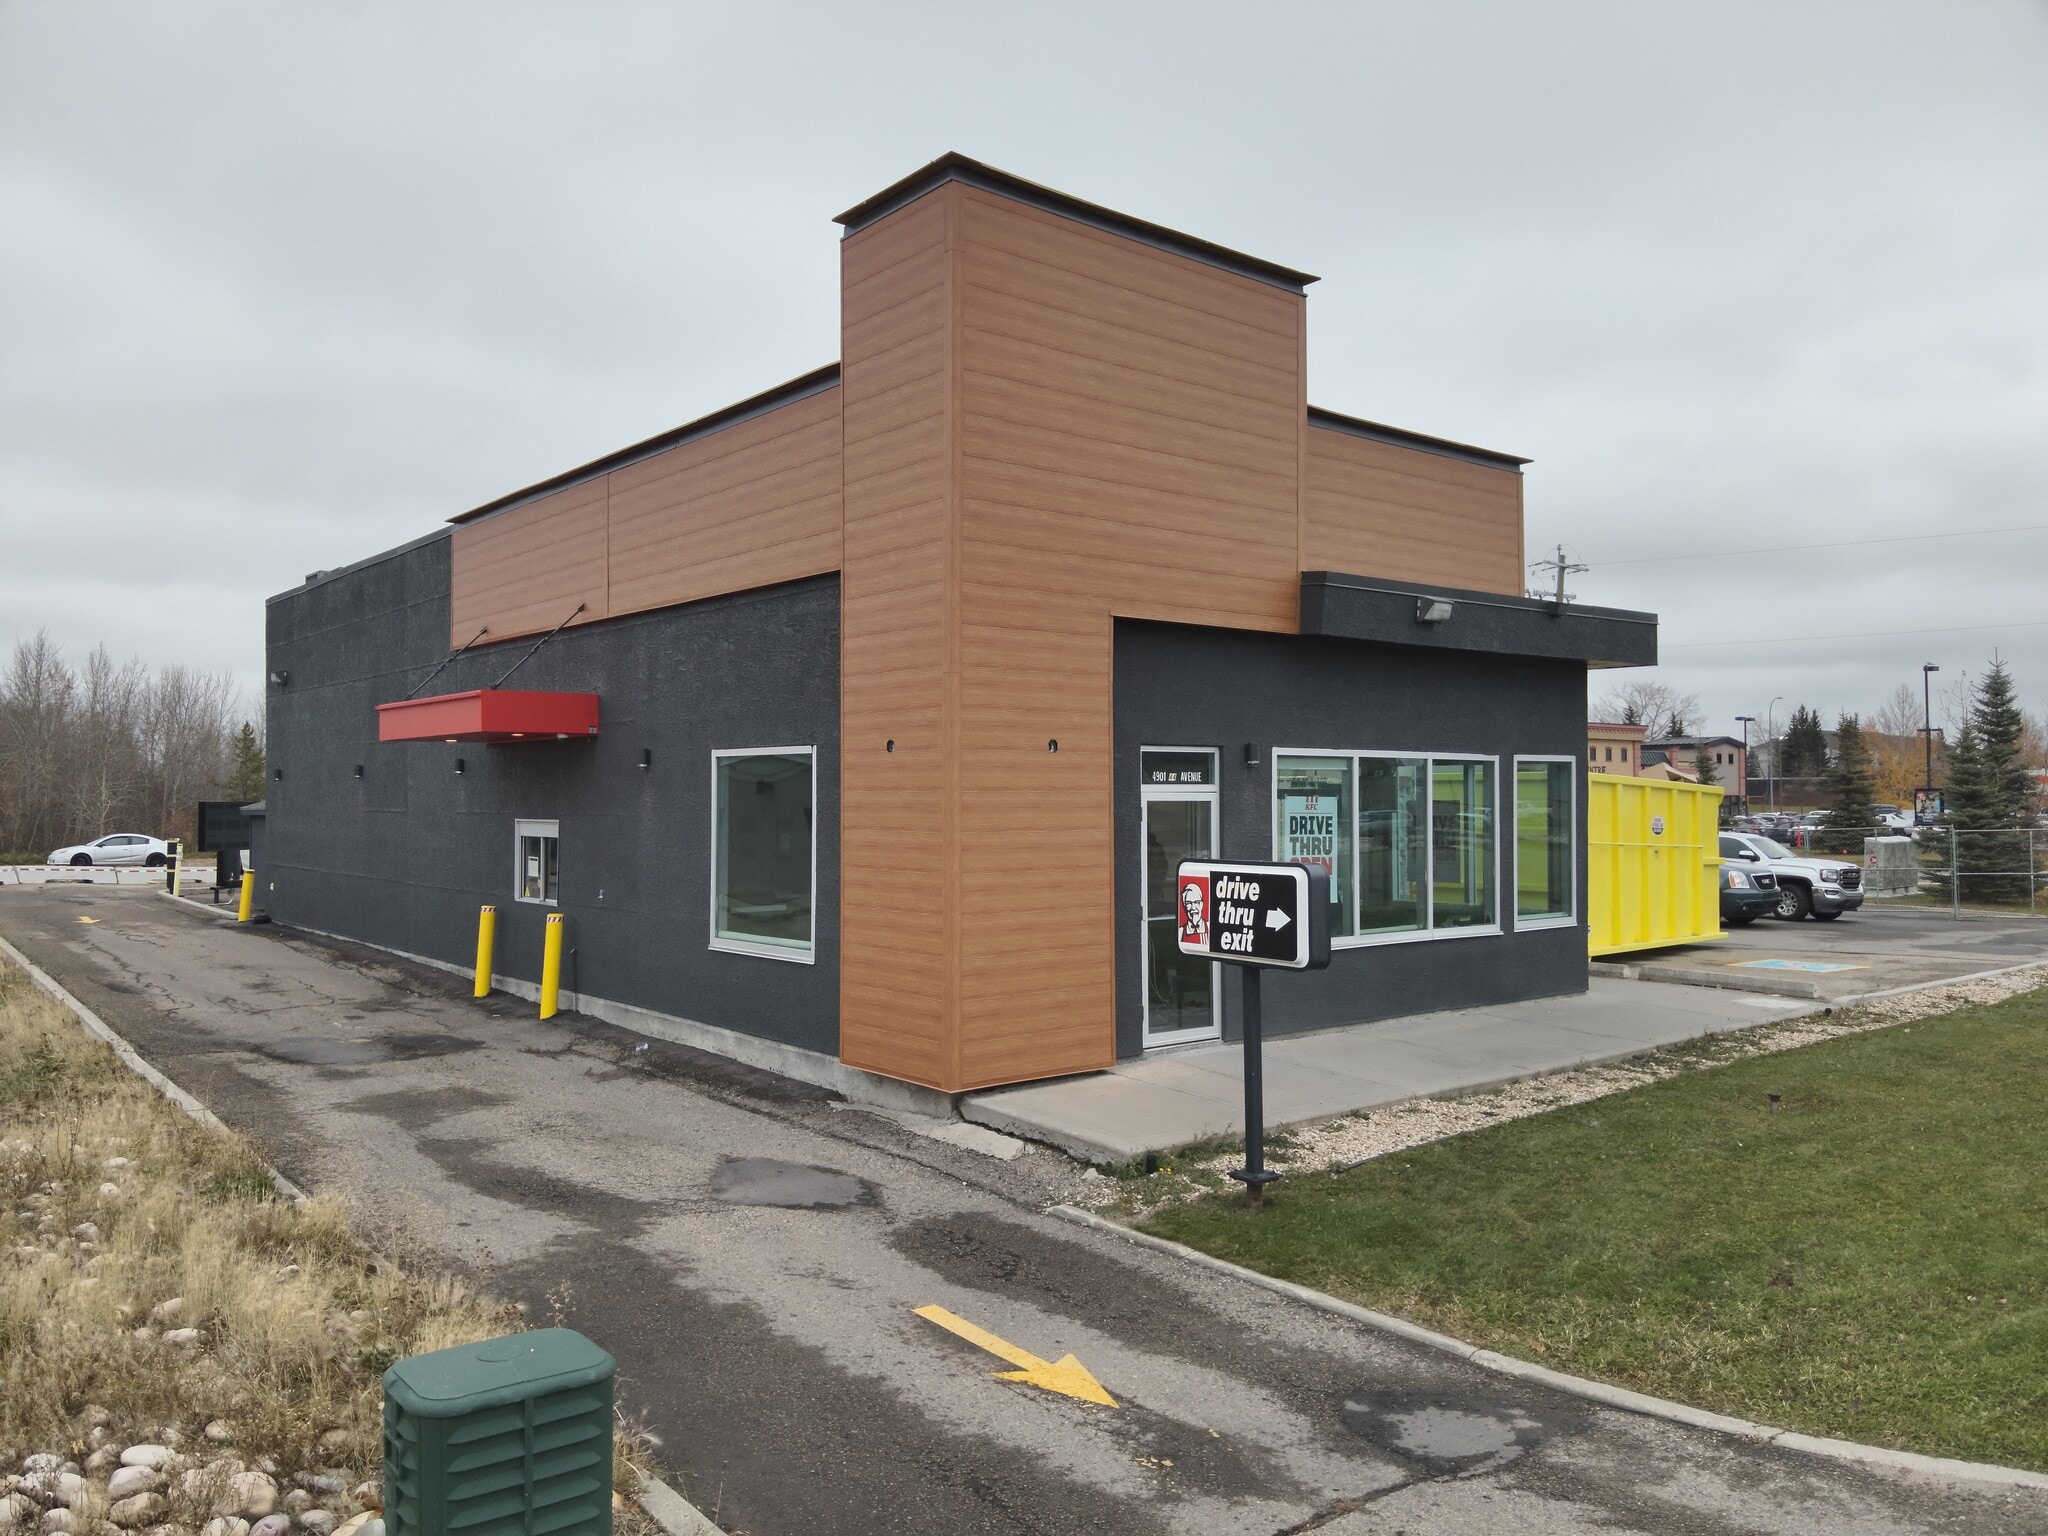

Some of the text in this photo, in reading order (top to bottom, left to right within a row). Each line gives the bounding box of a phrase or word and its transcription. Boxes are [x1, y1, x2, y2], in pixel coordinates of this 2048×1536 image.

[1152, 771, 1167, 782] 4901
[1180, 771, 1202, 782] AVENUE
[1305, 803, 1318, 811] KFC
[1289, 816, 1333, 835] DRIVE
[1289, 836, 1333, 856] THRU
[1216, 875, 1260, 901] drive
[1218, 901, 1255, 926] thru
[1220, 928, 1254, 952] exit
